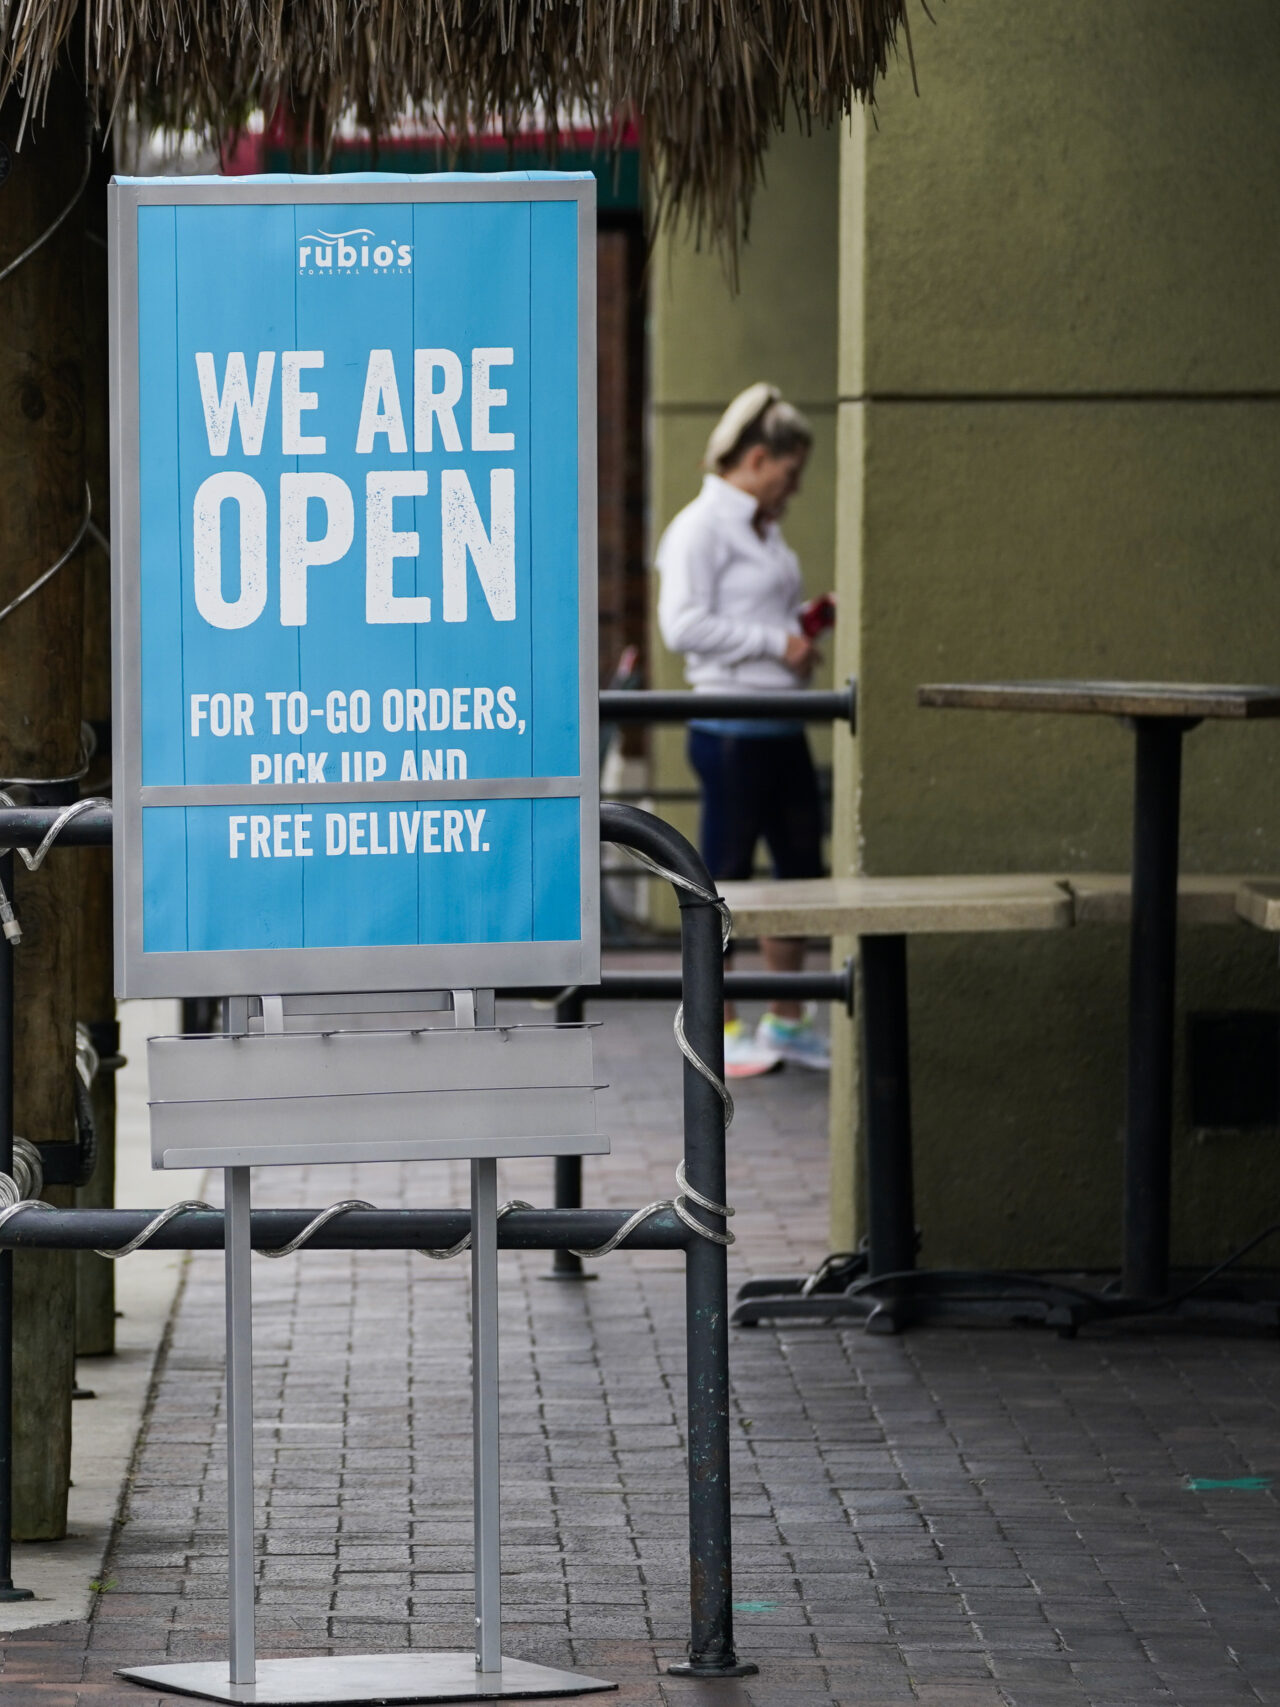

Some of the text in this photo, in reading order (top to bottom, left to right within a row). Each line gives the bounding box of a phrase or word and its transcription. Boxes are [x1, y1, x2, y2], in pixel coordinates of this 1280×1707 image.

[299, 235, 412, 268] rubio's
[299, 268, 360, 276] COASTAL
[195, 348, 515, 457] WE ARE
[193, 469, 516, 630] OPEN
[190, 685, 526, 737] FOR TO-GO ORDERS,
[251, 752, 328, 784] PICK
[228, 809, 490, 859] FREE DELIVERY.
